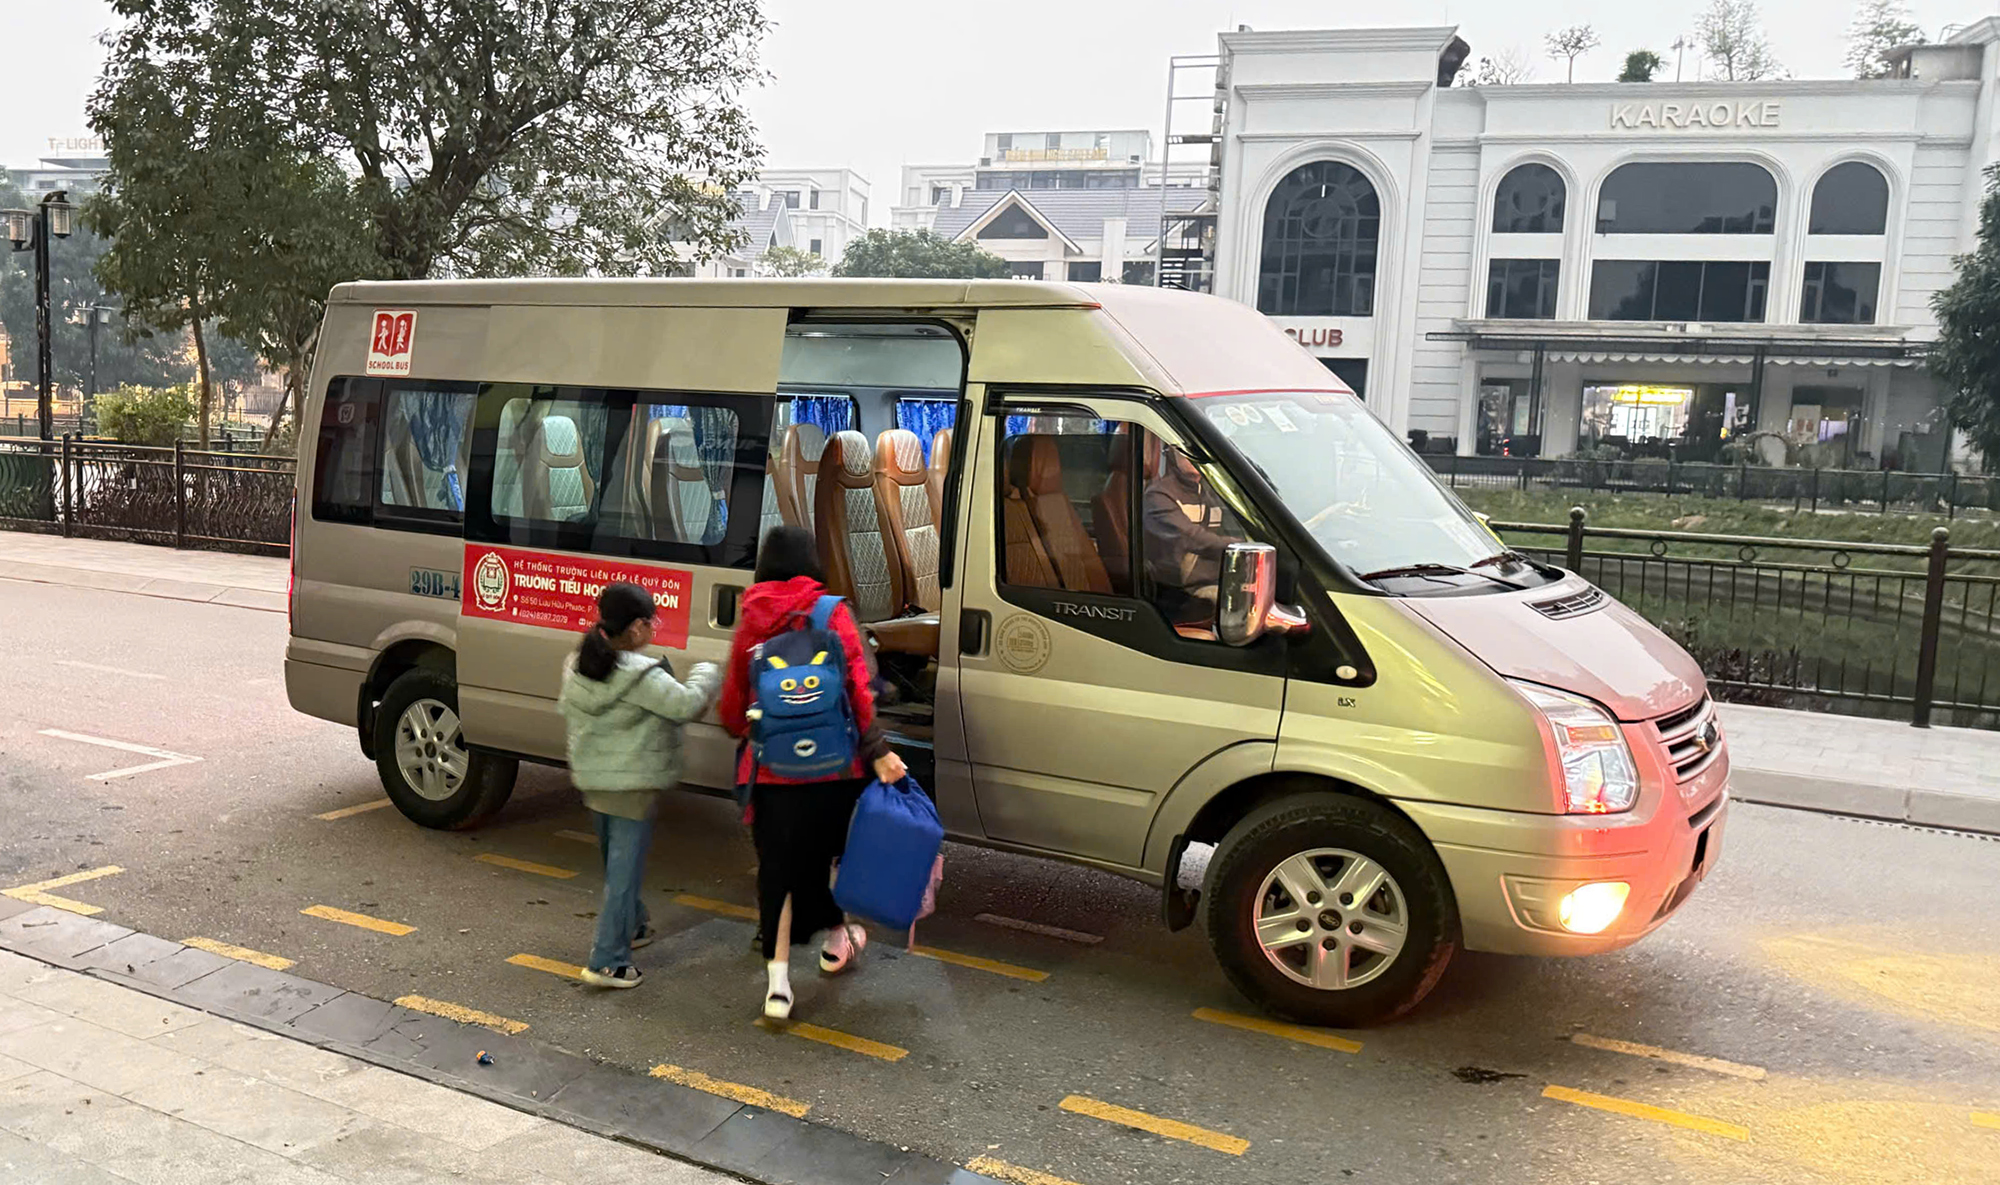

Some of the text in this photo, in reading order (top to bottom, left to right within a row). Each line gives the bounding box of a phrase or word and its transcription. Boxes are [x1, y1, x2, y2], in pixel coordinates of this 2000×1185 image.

[1611, 102, 1780, 129] KARAOKE
[368, 361, 409, 370] SCHOOL BUS
[513, 559, 524, 570] HỆ
[527, 561, 553, 573] THỐNG
[590, 570, 608, 580] LIÊN
[610, 571, 627, 582] CẤP
[629, 574, 640, 584] LÊ
[661, 579, 680, 590] ĐÔN
[529, 597, 538, 605] 50
[559, 576, 581, 595] TIỂU
[653, 591, 679, 609] ĐÔN
[1053, 601, 1137, 621] TRANSIT
